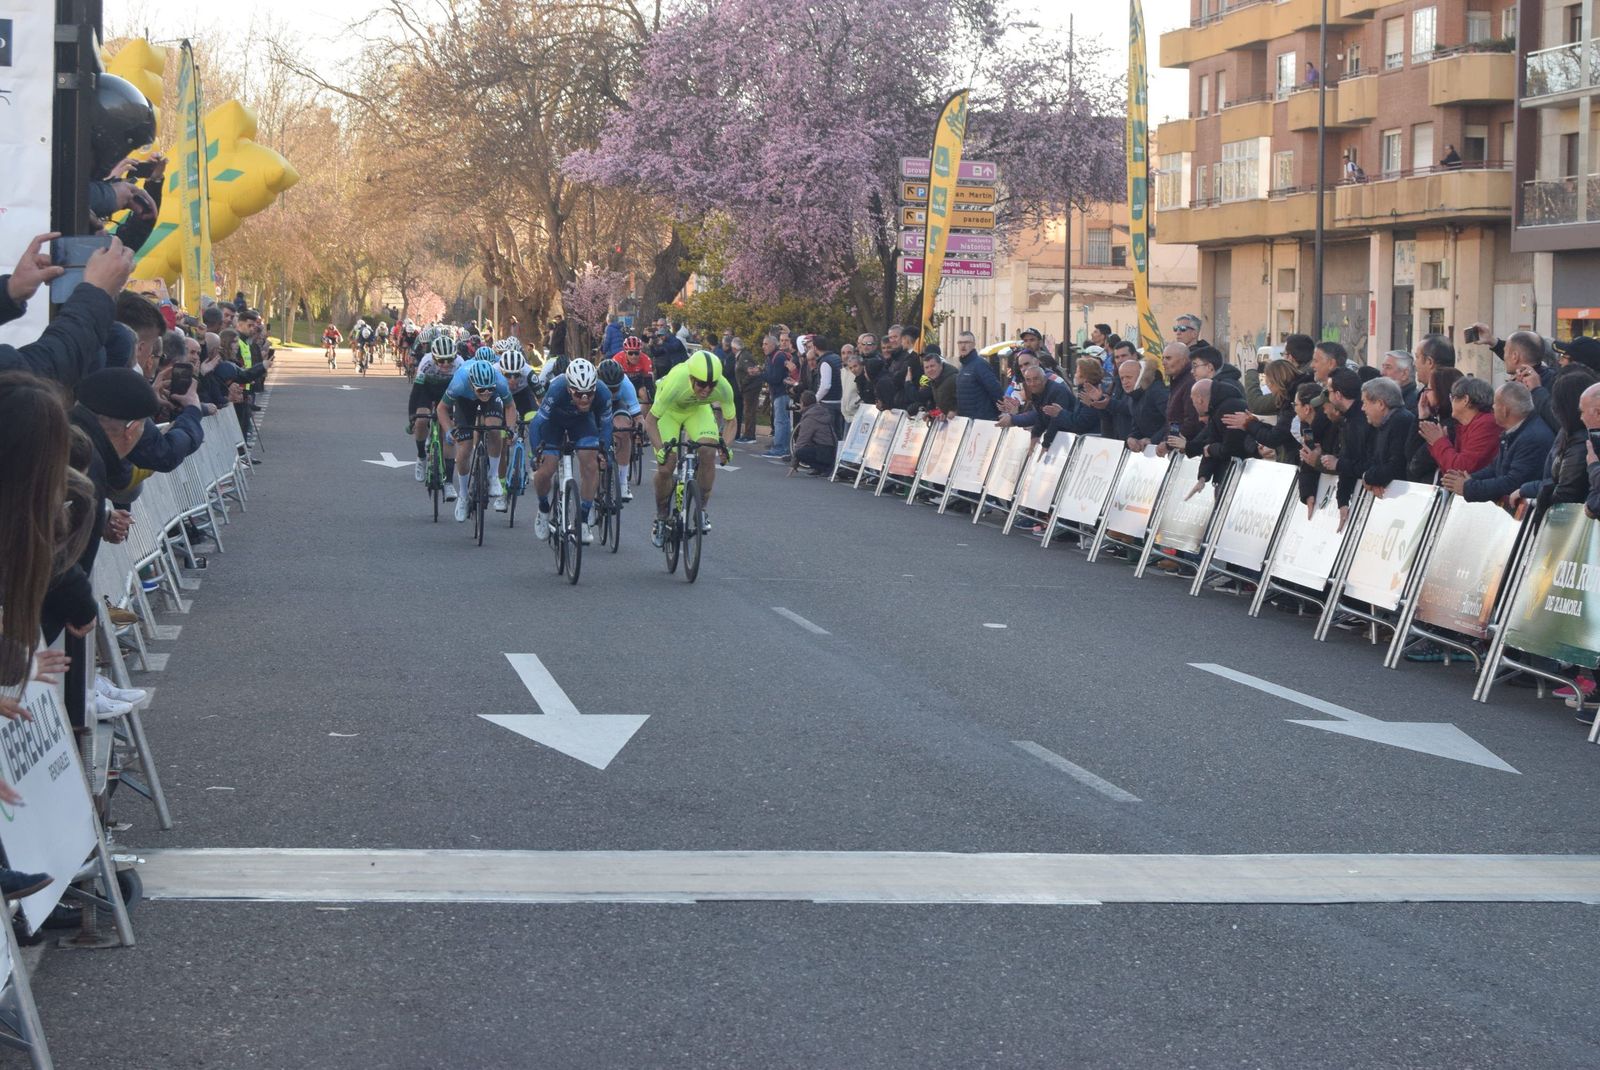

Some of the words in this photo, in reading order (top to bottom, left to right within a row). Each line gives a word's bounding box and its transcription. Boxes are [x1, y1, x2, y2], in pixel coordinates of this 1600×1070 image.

[906, 167, 929, 175] provin
[963, 216, 992, 224] parador
[1553, 560, 1578, 588] CAJA
[1544, 595, 1555, 611] DE
[1553, 596, 1583, 617] ZAMORA
